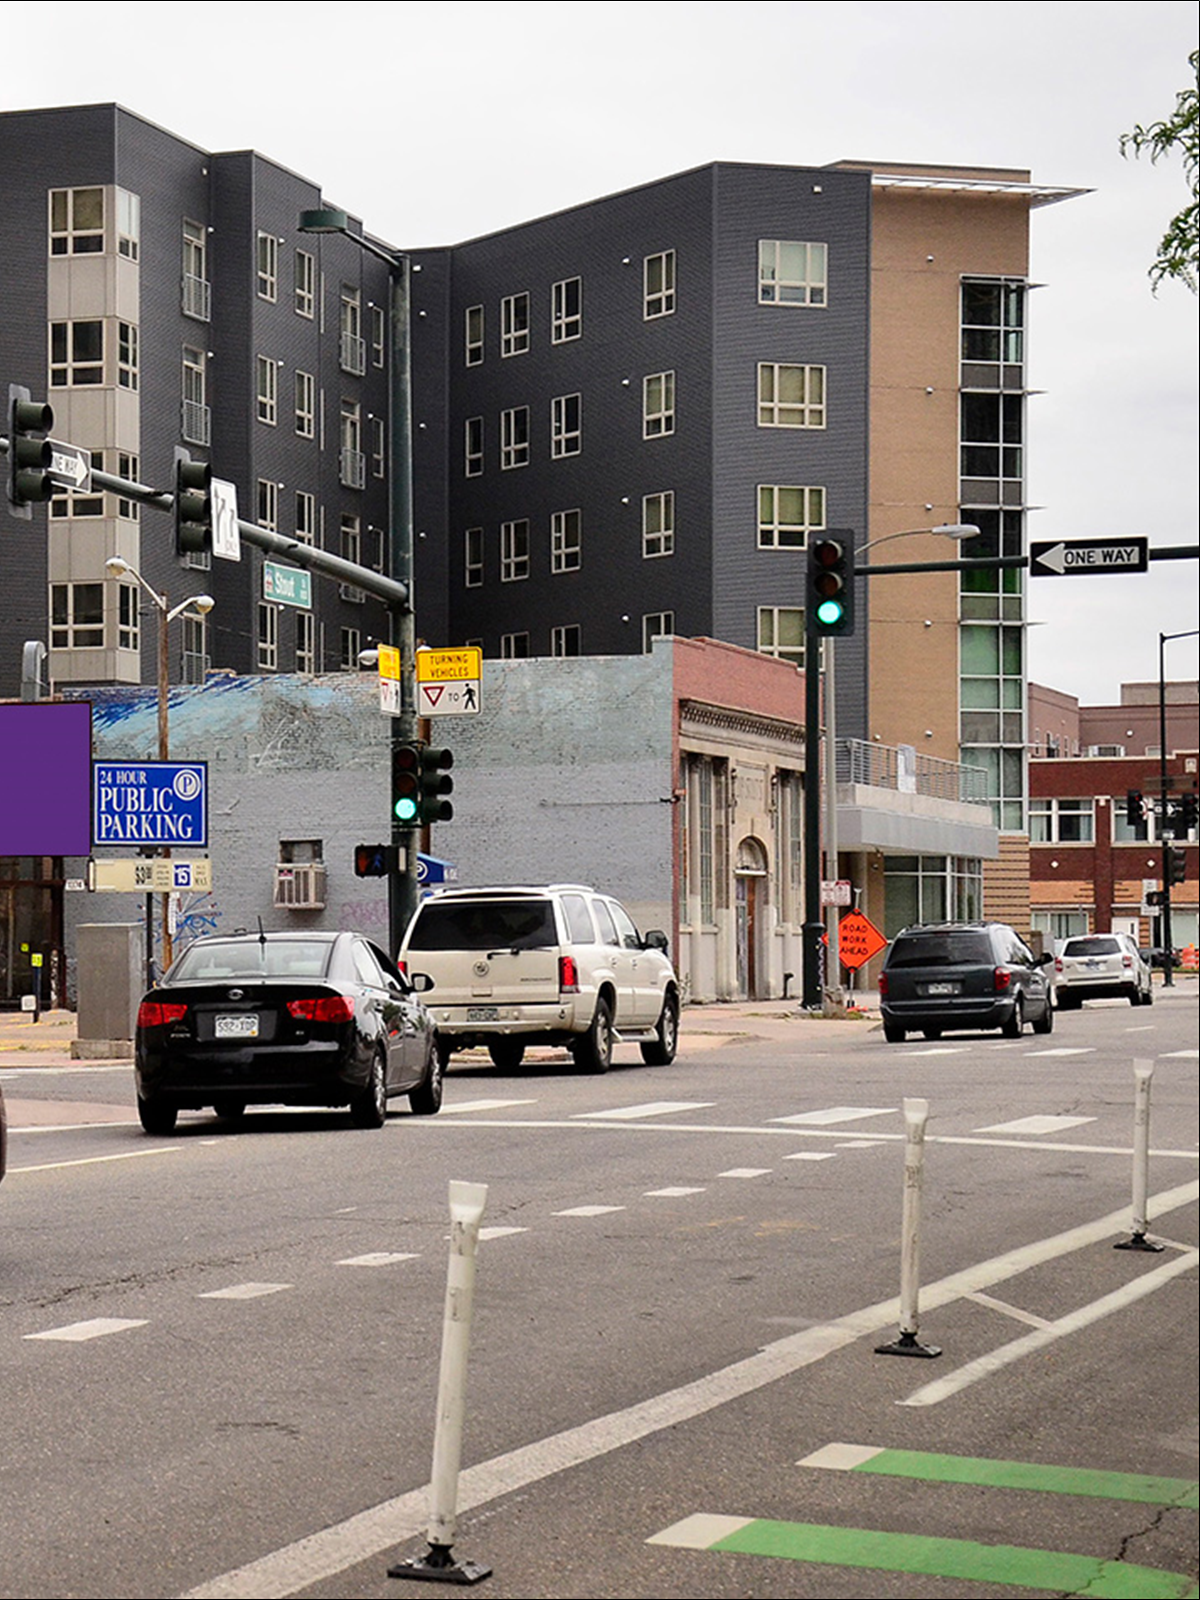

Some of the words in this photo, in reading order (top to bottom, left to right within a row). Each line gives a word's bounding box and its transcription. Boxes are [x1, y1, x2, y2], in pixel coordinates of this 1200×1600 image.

[1064, 549, 1097, 565] ONE
[1101, 548, 1135, 563] WAY
[429, 653, 468, 665] TURNING
[429, 667, 469, 678] VEHICLES
[448, 692, 459, 702] TO
[100, 770, 112, 784] 24
[116, 770, 147, 784] HOUR
[183, 776, 192, 793] P
[100, 787, 173, 812] PUBLIC
[100, 813, 193, 839] PARKING
[842, 923, 868, 933] ROAD
[842, 935, 867, 944] WORK
[841, 946, 869, 956] AHEAD
